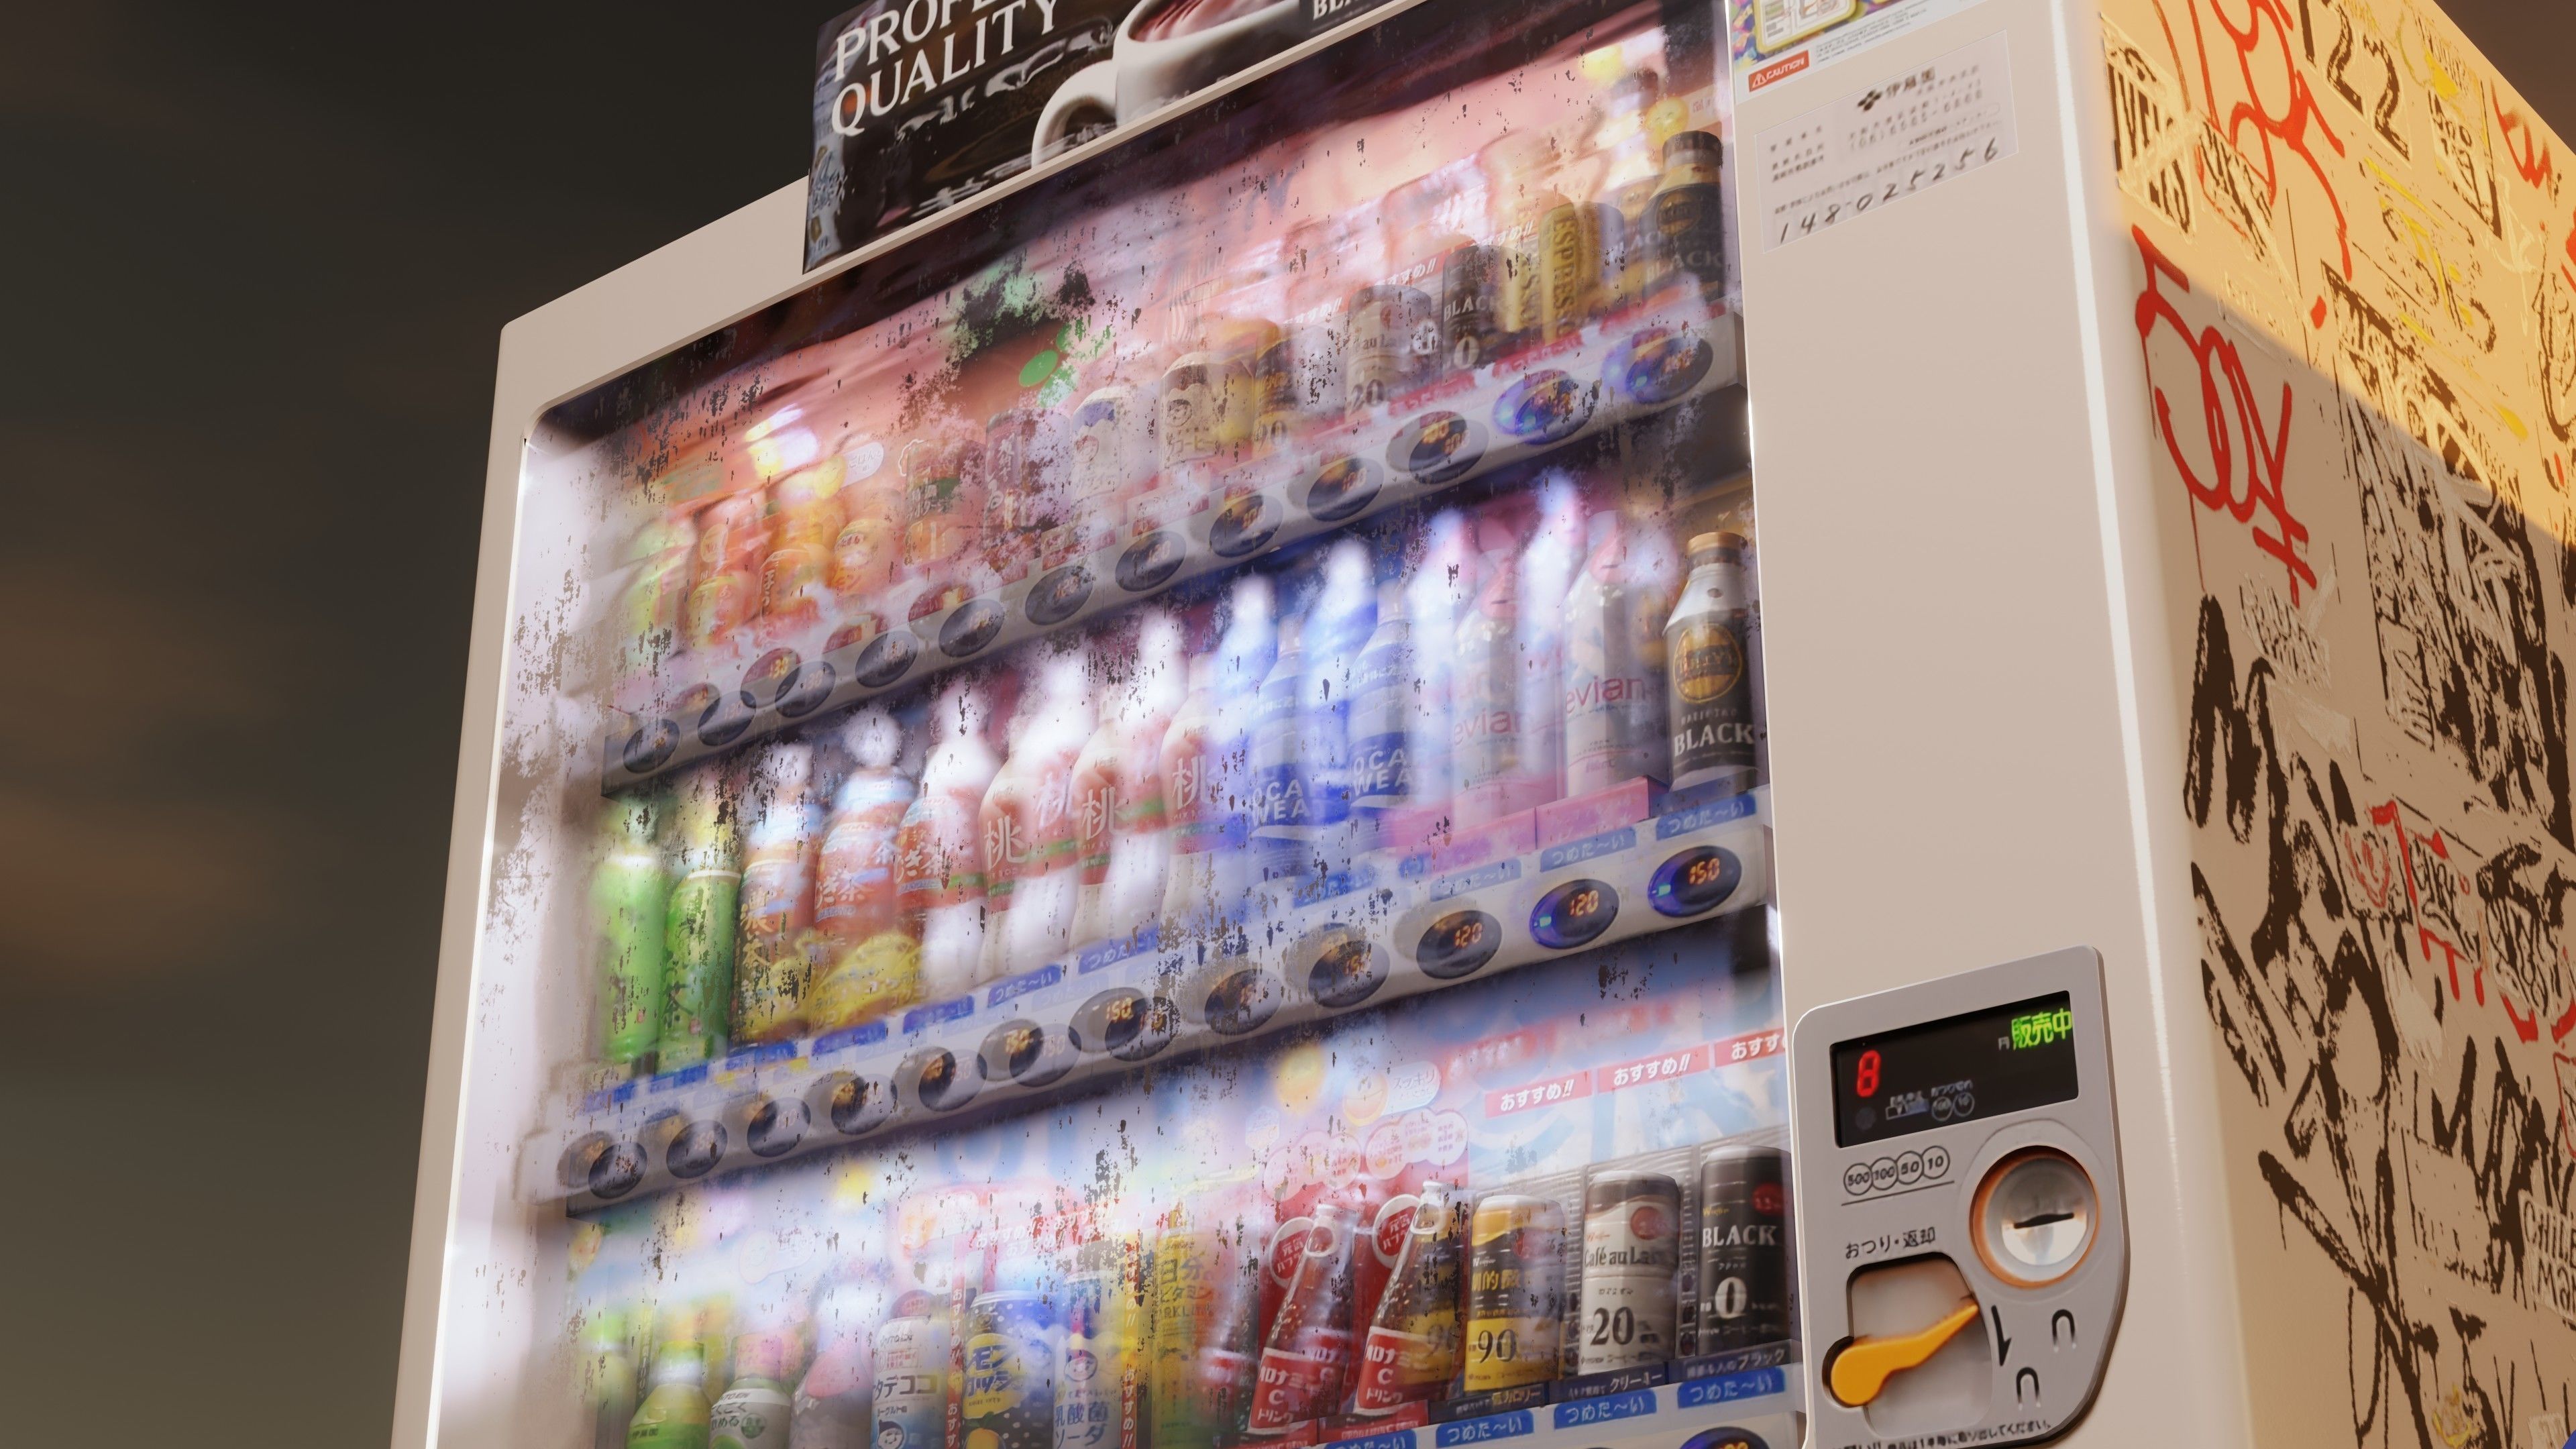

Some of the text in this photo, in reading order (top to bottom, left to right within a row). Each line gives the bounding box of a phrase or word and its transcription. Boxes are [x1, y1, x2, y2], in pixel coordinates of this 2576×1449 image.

[1313, 0, 1352, 21] BL
[831, 0, 1057, 136] QUALITY
[1444, 294, 1495, 321] BLAC
[1565, 675, 1646, 715] evian
[1674, 723, 1755, 757] BLACK
[1081, 786, 1127, 841] 桃
[984, 815, 1029, 871] 桃
[1688, 857, 1720, 885] 150
[1570, 890, 1599, 917] 120
[1998, 1008, 2073, 1051] 円 販売中
[1614, 1053, 1691, 1087] おすすめ!!
[1856, 1050, 1881, 1098] 8
[1501, 1079, 1574, 1112] おすすめ!!
[1847, 1155, 1944, 1185] 500 100 50 10
[1703, 1224, 1778, 1248] BLACK
[1845, 1226, 1936, 1260] おつり・返却
[1609, 1250, 1627, 1265] au
[1715, 1277, 1747, 1320] 0
[1591, 1306, 1635, 1346] 20
[1478, 1328, 1517, 1363] 90
[873, 1375, 938, 1401] タデココ
[1377, 1368, 1394, 1385] C
[1269, 1389, 1285, 1405] C
